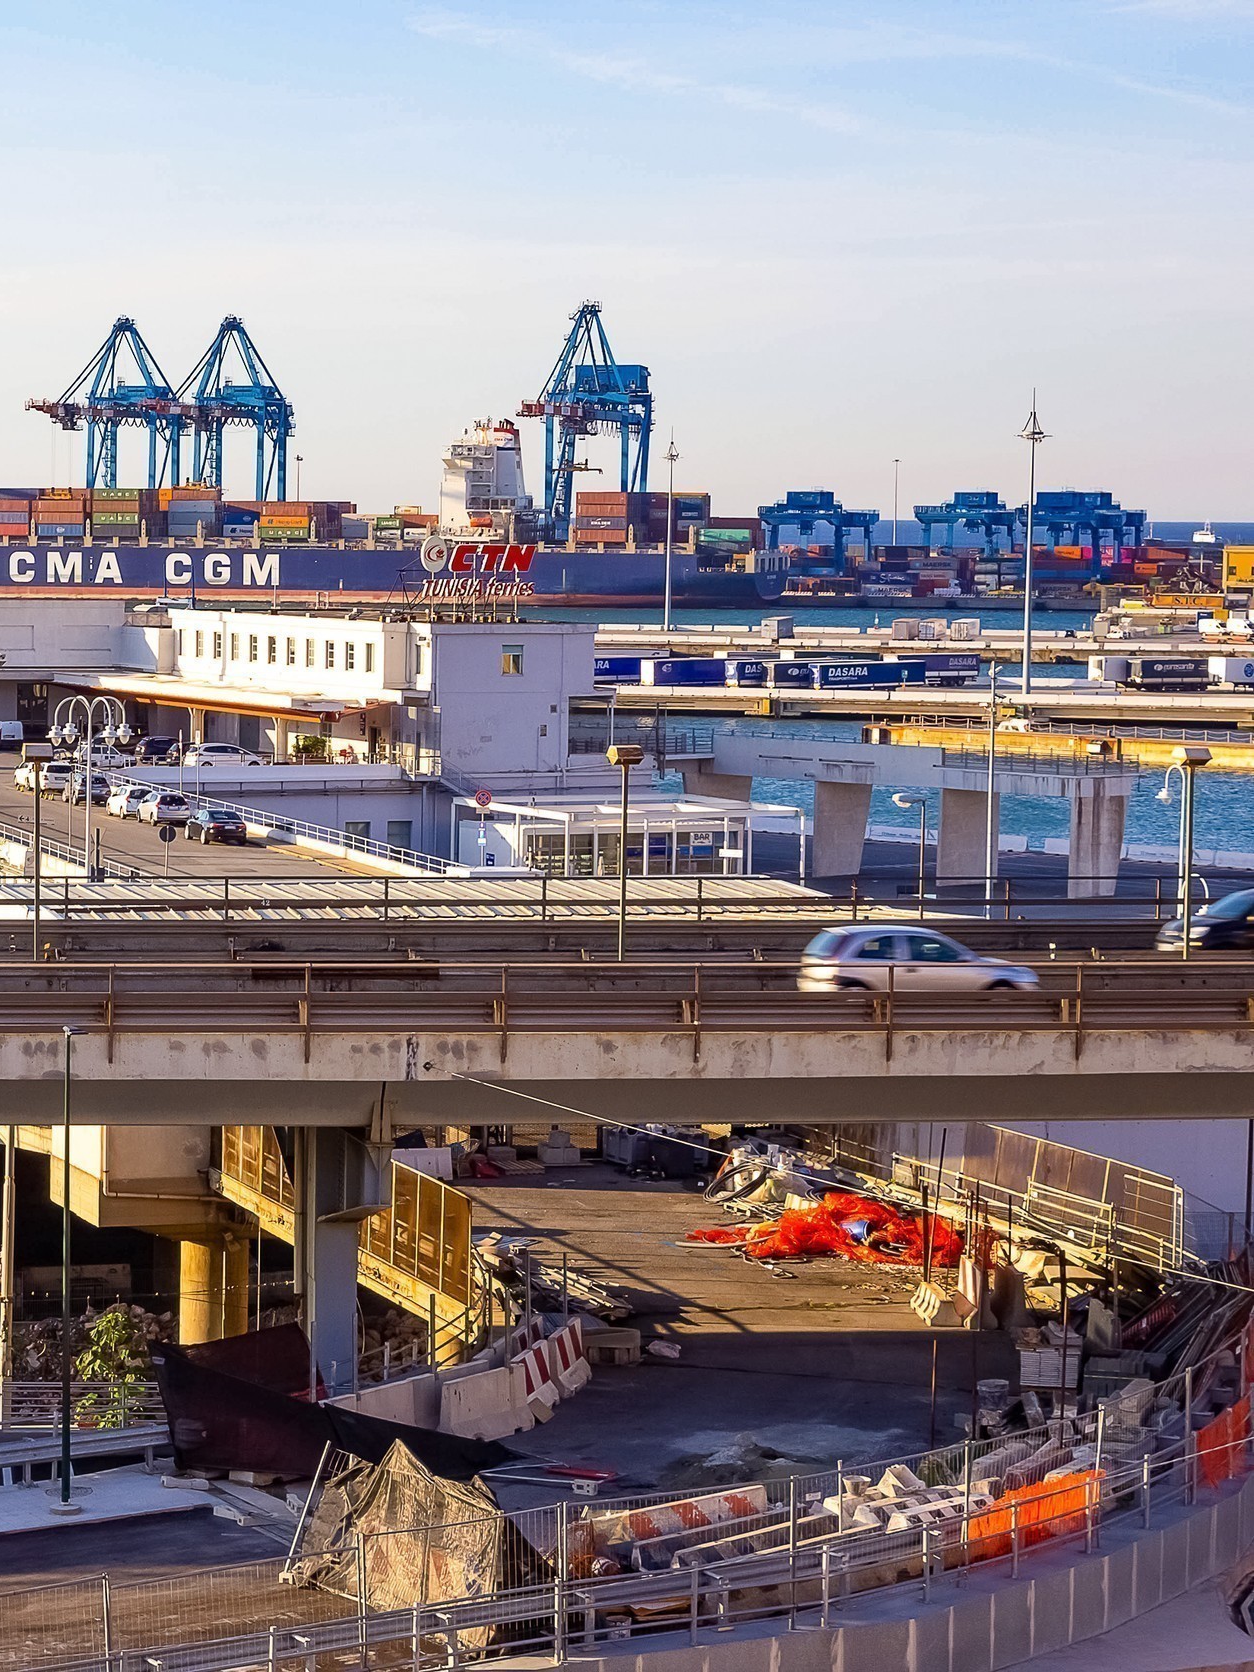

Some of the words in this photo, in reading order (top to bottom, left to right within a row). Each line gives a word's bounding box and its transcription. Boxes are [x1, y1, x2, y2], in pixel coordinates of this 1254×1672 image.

[8, 551, 124, 584] CMA
[164, 552, 280, 586] CGM
[448, 543, 537, 573] CTN
[422, 578, 483, 598] TUNISIA
[486, 576, 536, 597] ferries
[828, 666, 869, 677] DASARA
[948, 657, 977, 666] DASARA
